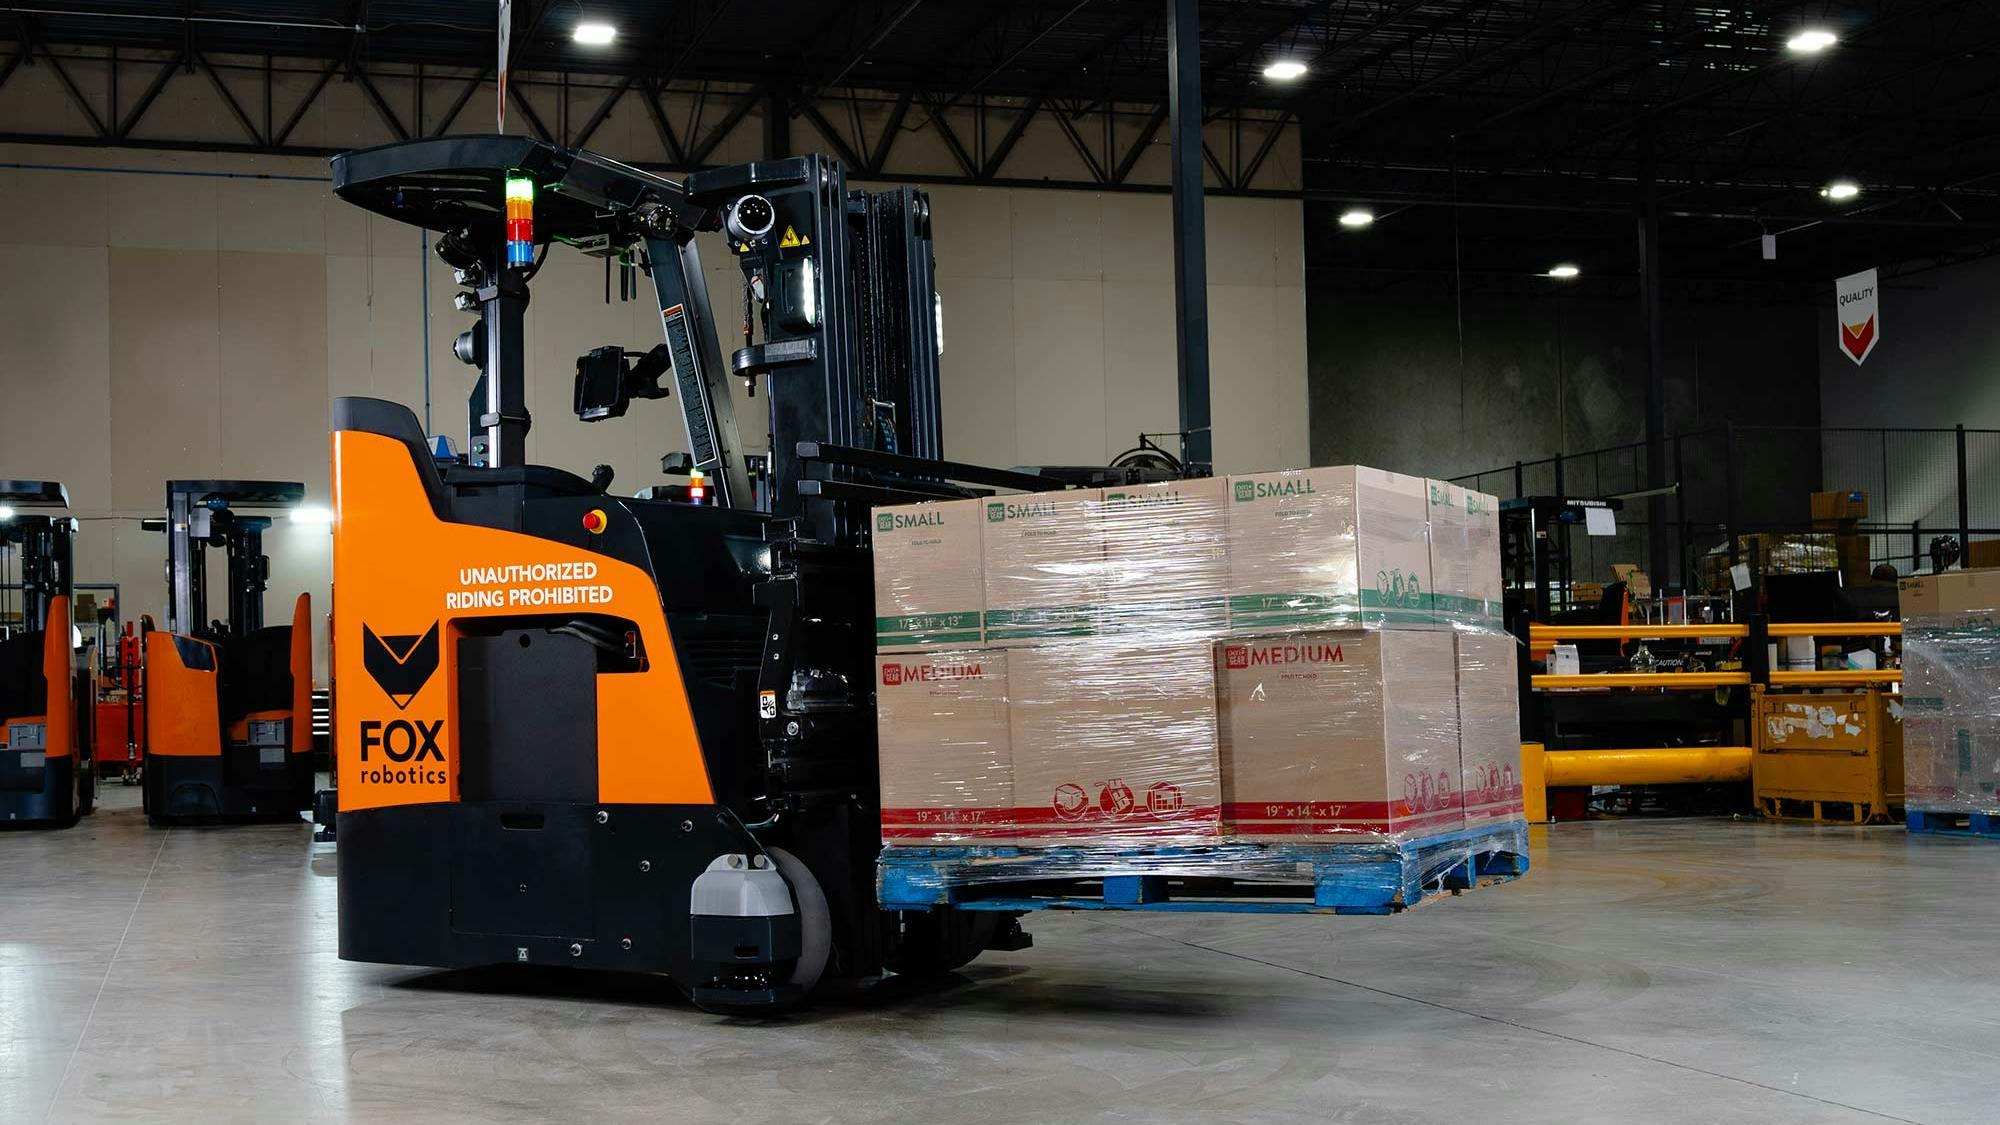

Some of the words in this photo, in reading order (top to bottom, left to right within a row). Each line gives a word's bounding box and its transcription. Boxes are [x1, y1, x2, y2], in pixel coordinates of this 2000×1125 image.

[1839, 287, 1874, 306] QUALITY
[1256, 478, 1316, 498] SMALL
[1007, 501, 1057, 519] SMALL
[895, 511, 945, 529] SMALL
[459, 562, 598, 585] UNAUTHORIZED
[446, 590, 504, 609] RIDING
[509, 586, 613, 606] PROHIBITED
[948, 615, 963, 626] 13"
[1251, 644, 1344, 666] MEDIUM
[903, 663, 983, 682] MEDIUM
[360, 719, 446, 763] FOX
[360, 764, 447, 785] robotics
[916, 811, 932, 822] 19"
[934, 814, 941, 822] x
[962, 814, 969, 822] x
[971, 810, 986, 822] 17"
[1265, 804, 1284, 817] 19"
[1287, 808, 1294, 817] x
[1319, 808, 1327, 817] x
[1330, 804, 1347, 817] 17"
